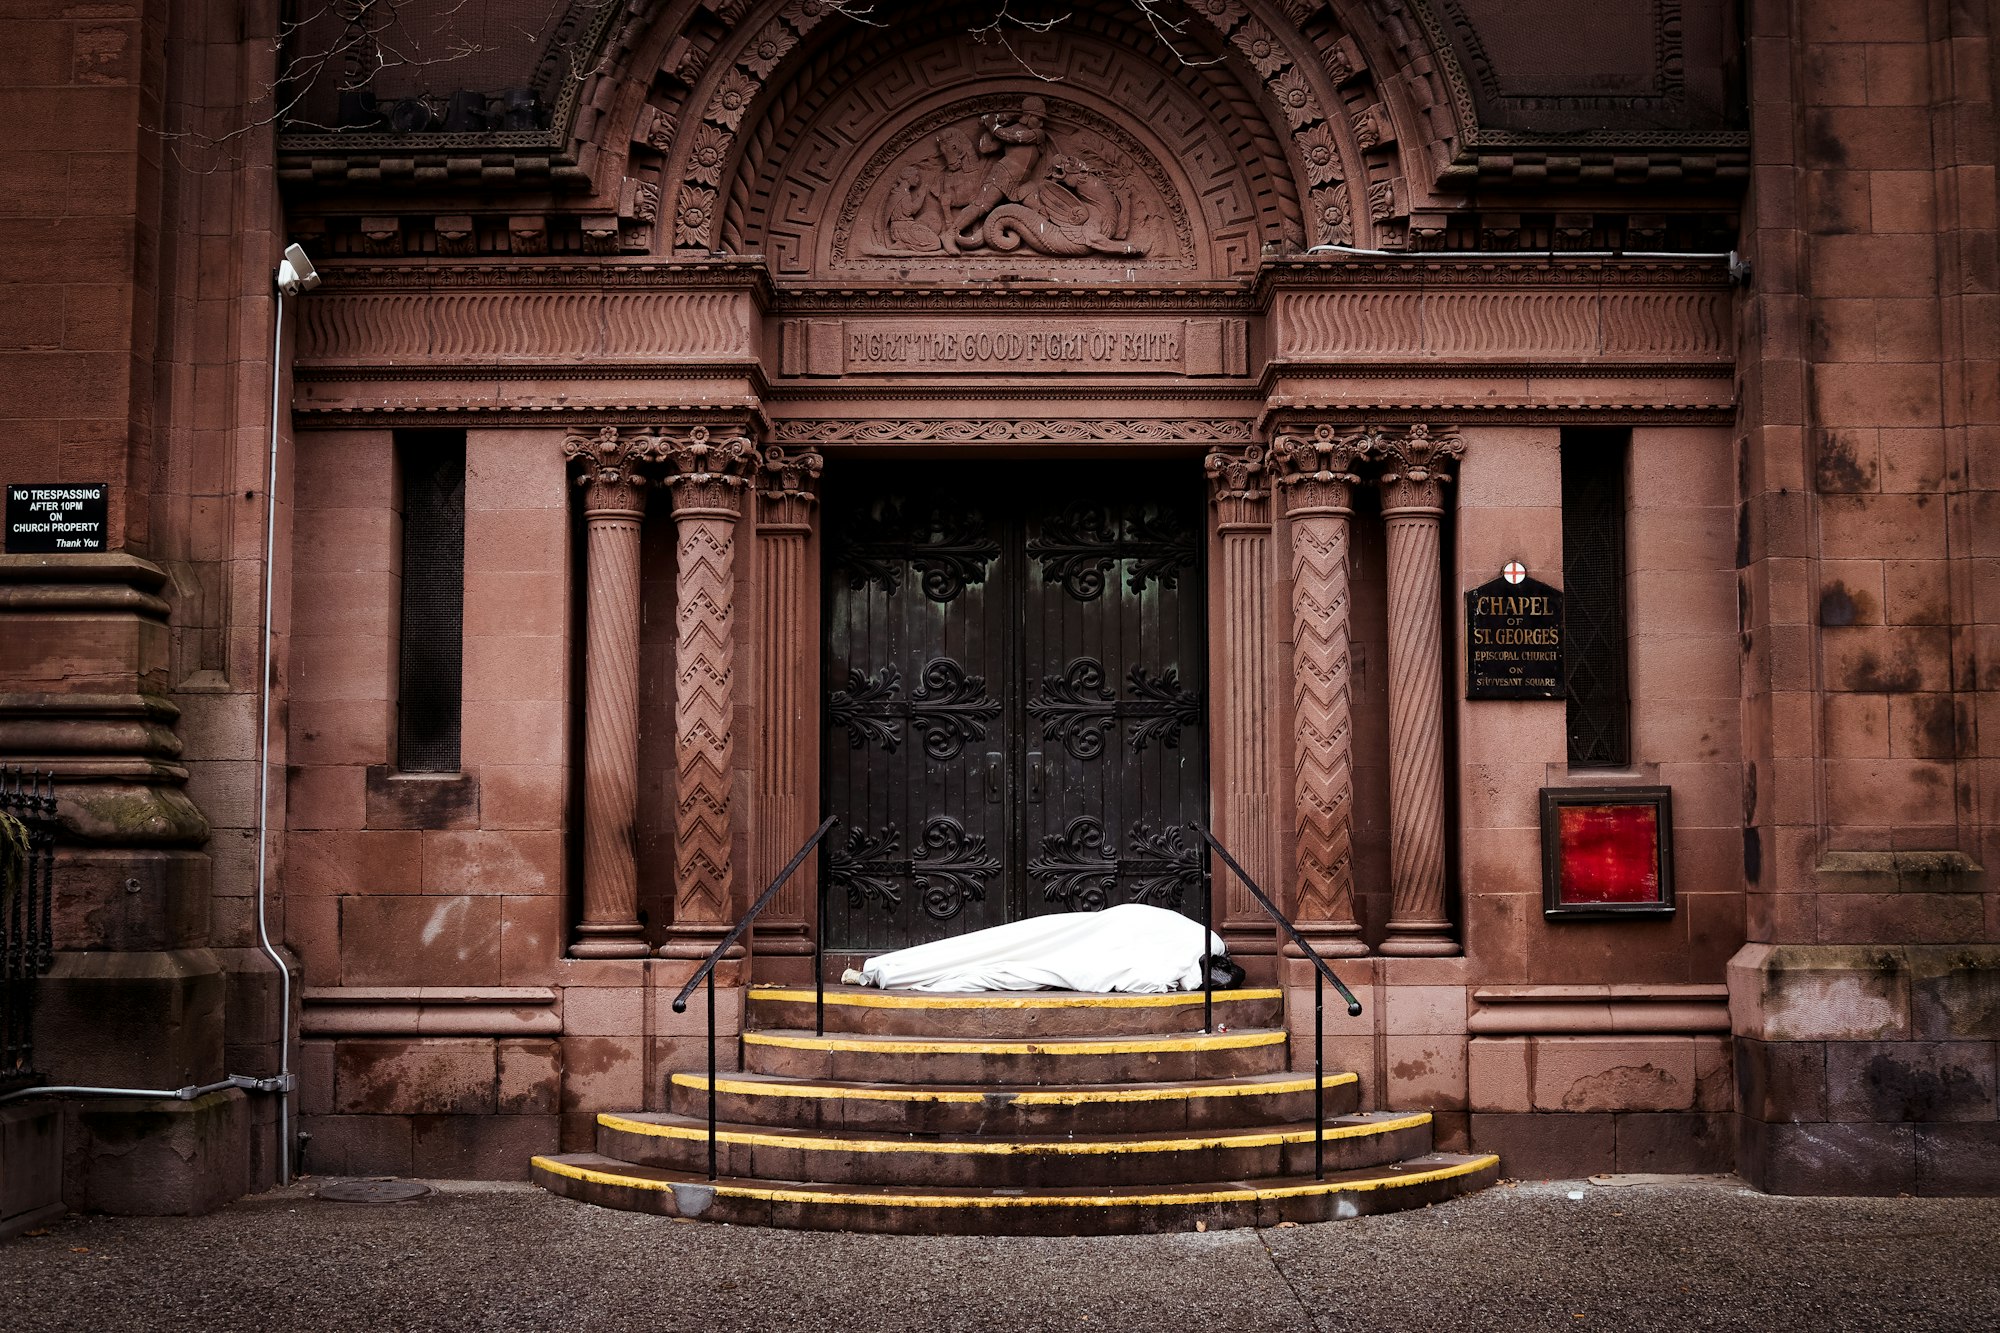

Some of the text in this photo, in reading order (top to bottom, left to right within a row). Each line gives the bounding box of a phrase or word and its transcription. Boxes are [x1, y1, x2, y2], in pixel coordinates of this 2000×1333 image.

[961, 333, 1024, 361] GOOD
[1089, 333, 1117, 361] OF
[13, 489, 100, 500] NO TRESPASSING
[29, 501, 83, 511] AFTER 10PM
[49, 512, 62, 521] ON
[13, 522, 99, 532] CHURCH PROPERTY
[56, 538, 99, 548] Thank You
[1477, 596, 1554, 616] CHAPEL
[1507, 617, 1523, 626] OF
[1474, 628, 1493, 645] ST.
[1475, 651, 1557, 661] EPISCOPAL CHURCH
[1525, 678, 1556, 687] SQUARE
